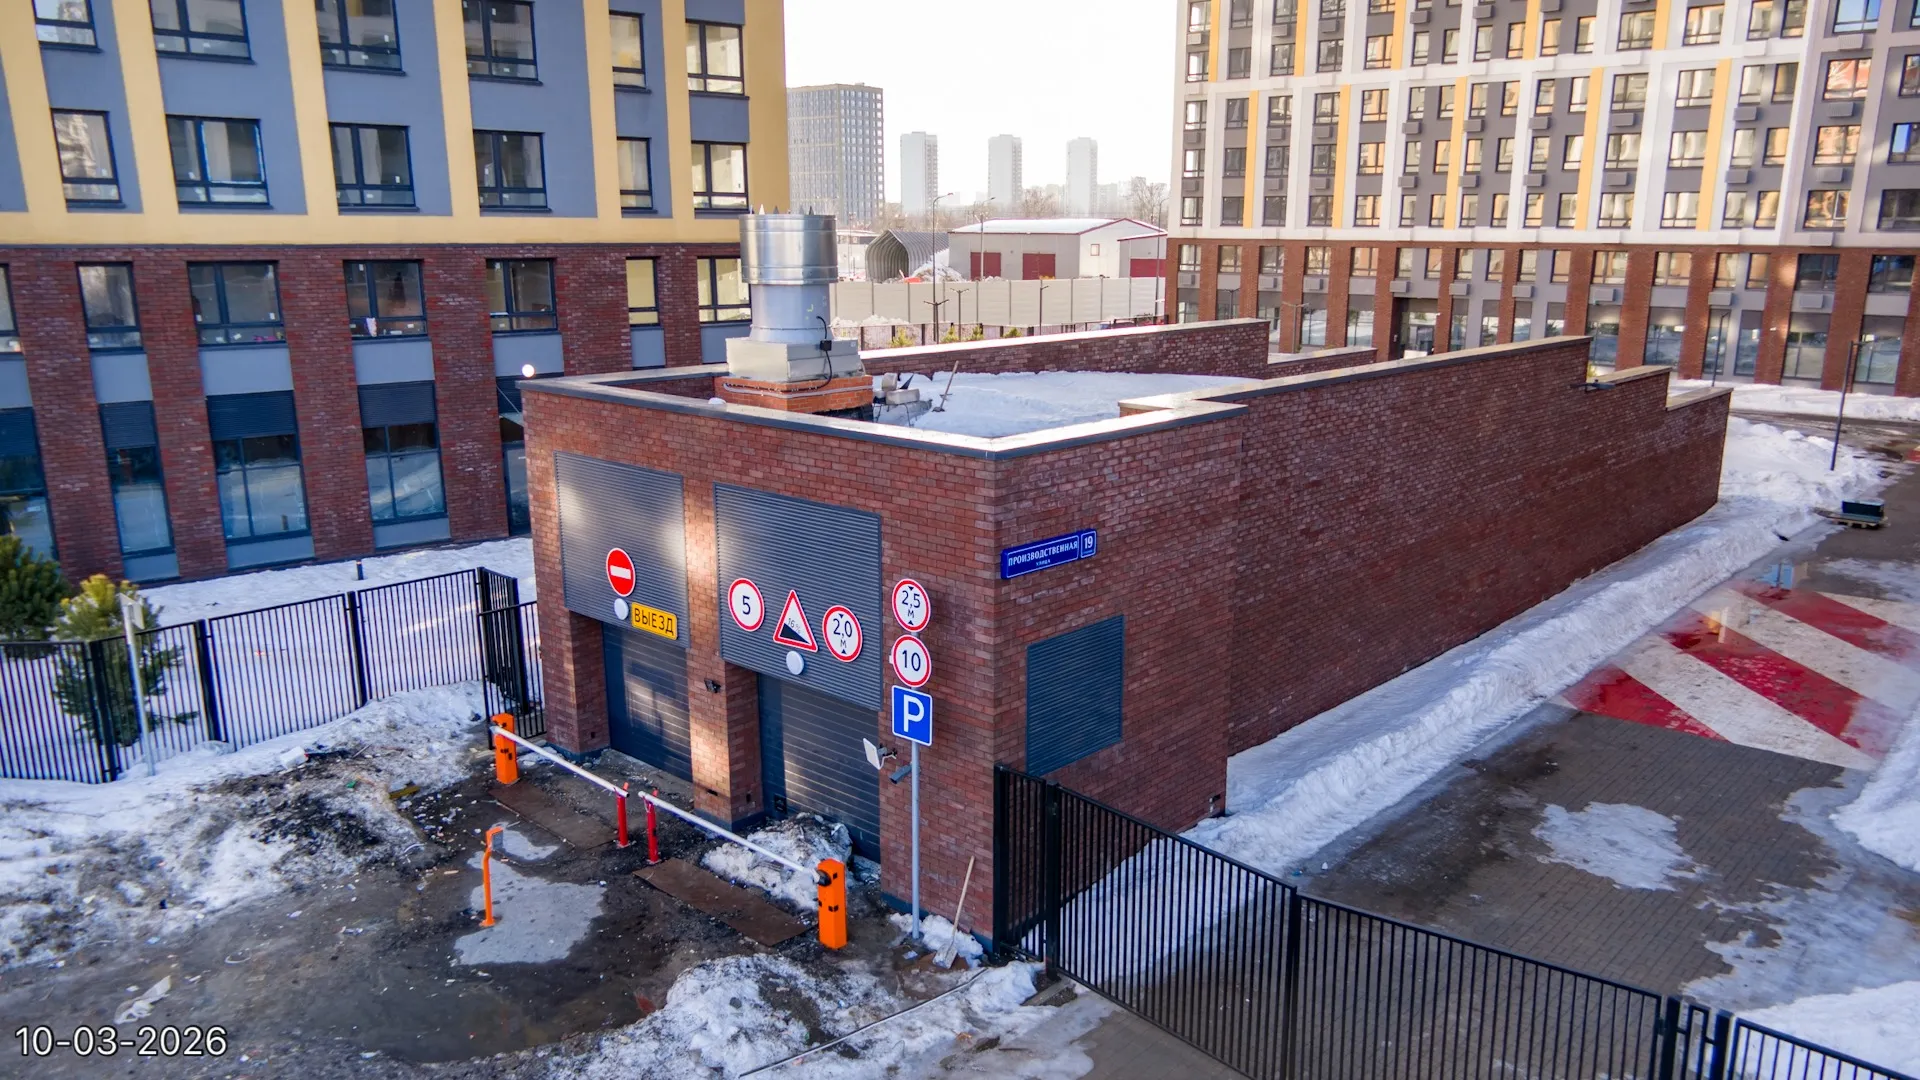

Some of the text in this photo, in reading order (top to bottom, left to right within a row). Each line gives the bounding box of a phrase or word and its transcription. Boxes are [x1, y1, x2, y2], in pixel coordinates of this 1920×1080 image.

[1084, 535, 1093, 549] 19
[1008, 541, 1078, 566] ПРОИЗВОДСТВЕННАЯ
[742, 595, 751, 615] 5
[901, 590, 921, 609] 2,5
[634, 607, 674, 636] ВЫЕЗД
[833, 618, 852, 638] 2,0
[902, 650, 921, 672] 10
[903, 694, 925, 732] P
